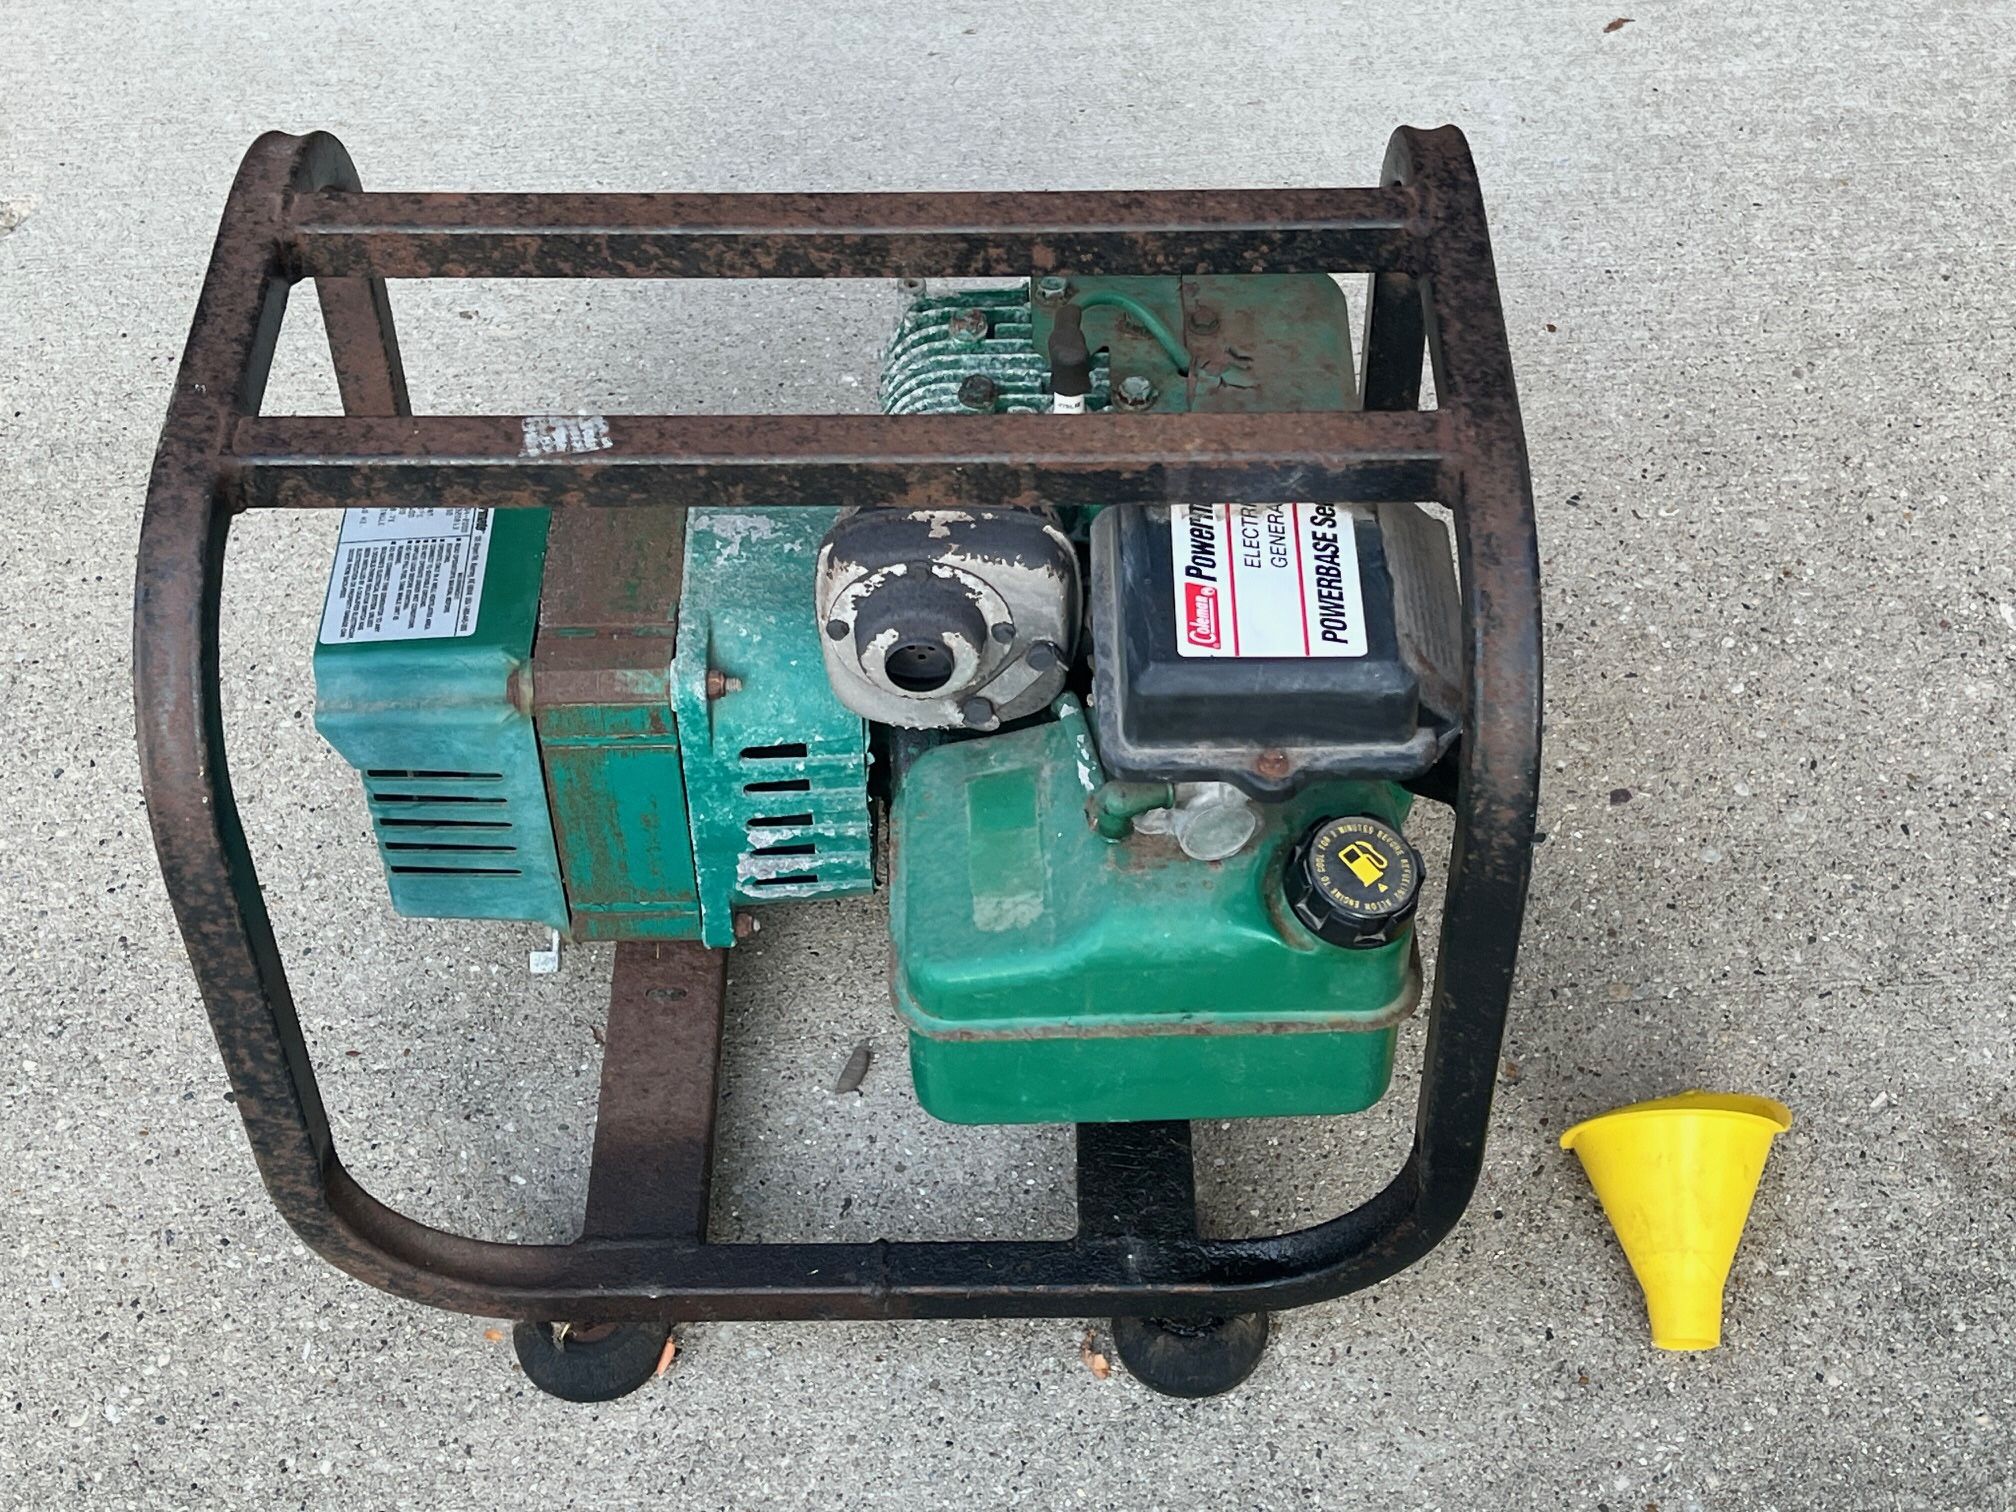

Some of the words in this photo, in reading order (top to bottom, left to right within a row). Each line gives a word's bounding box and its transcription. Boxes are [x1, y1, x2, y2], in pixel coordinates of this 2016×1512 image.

[1312, 531, 1348, 644] POWERBASE
[1189, 595, 1215, 643] Coleman
[1338, 824, 1374, 835] MINUTES
[1318, 836, 1331, 850] FOR
[1377, 830, 1404, 856] BEFORE
[1315, 854, 1325, 872] COOL
[1321, 876, 1331, 886] TO
[1330, 888, 1360, 908] ENGINE
